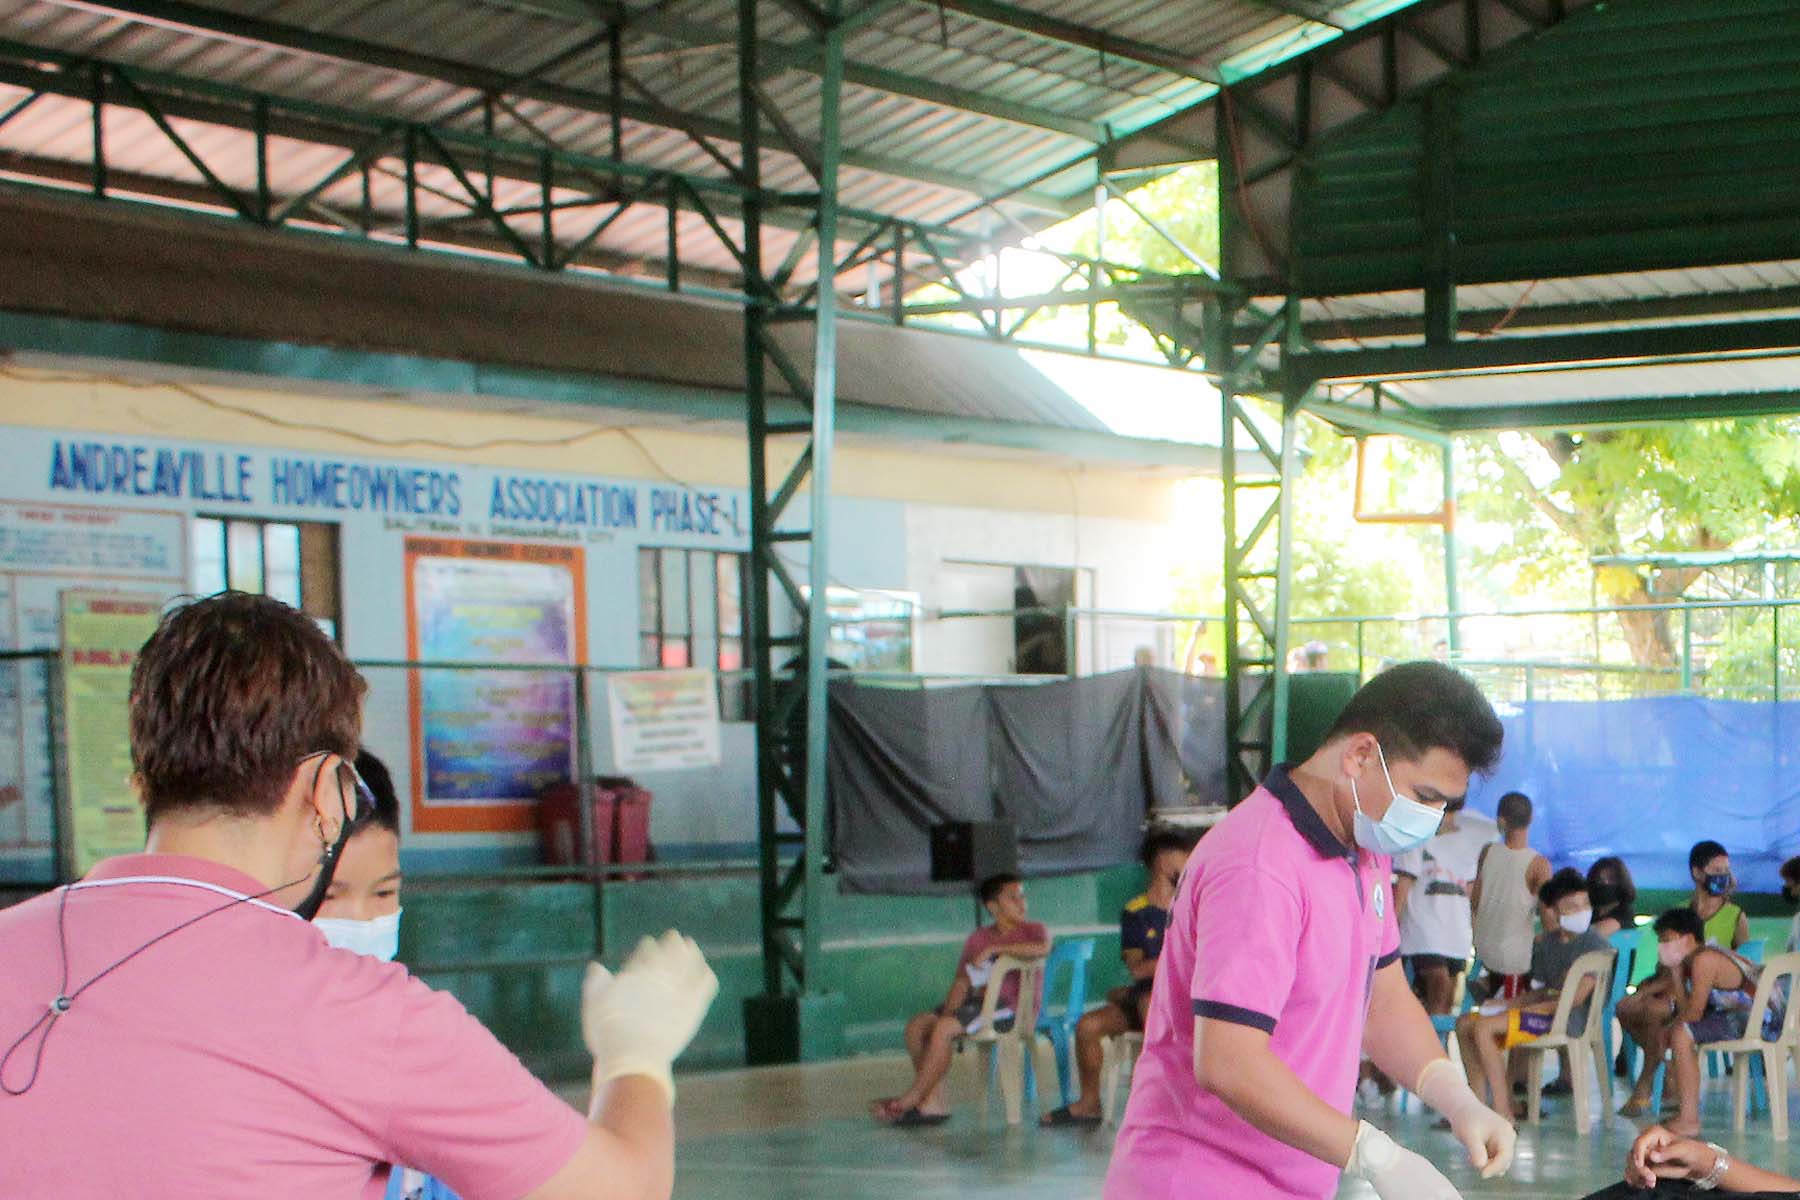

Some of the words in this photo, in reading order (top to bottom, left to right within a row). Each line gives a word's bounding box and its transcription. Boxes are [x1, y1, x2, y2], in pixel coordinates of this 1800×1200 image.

[50, 438, 255, 503] ANDREAVILLE
[270, 457, 462, 517] HOMEOWNERS
[489, 475, 638, 529] ASSOCIATION
